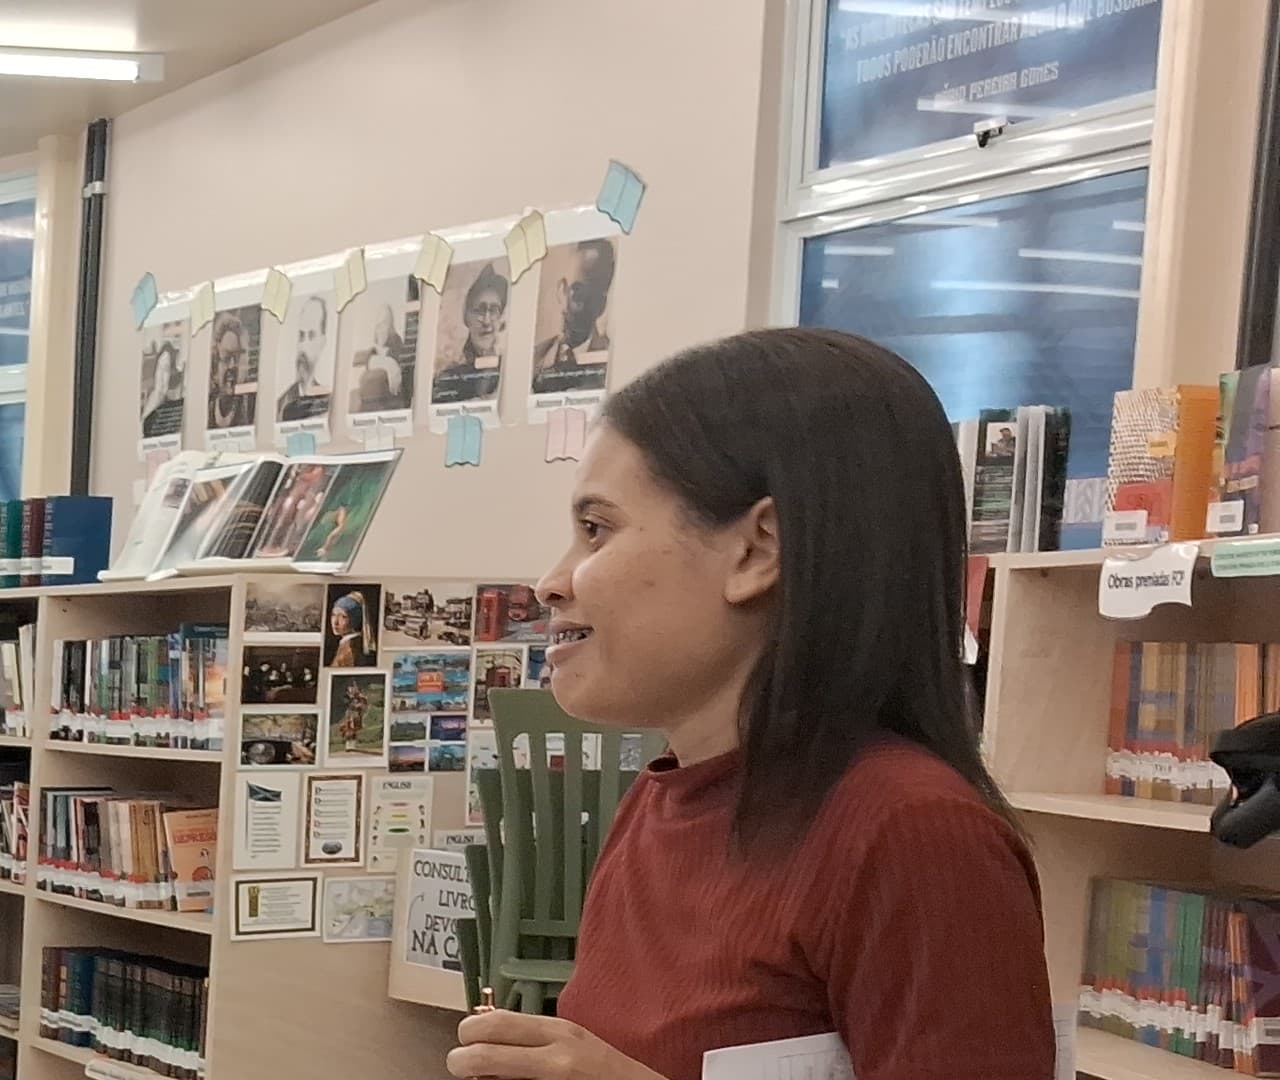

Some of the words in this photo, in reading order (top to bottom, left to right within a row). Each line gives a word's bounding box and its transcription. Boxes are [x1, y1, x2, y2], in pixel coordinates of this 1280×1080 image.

[893, 34, 945, 74] PODERÃO
[947, 21, 1018, 60] ENCONTRAR
[1107, 573, 1133, 589] Obras
[1135, 570, 1170, 591] premiadas
[411, 929, 438, 955] NA
